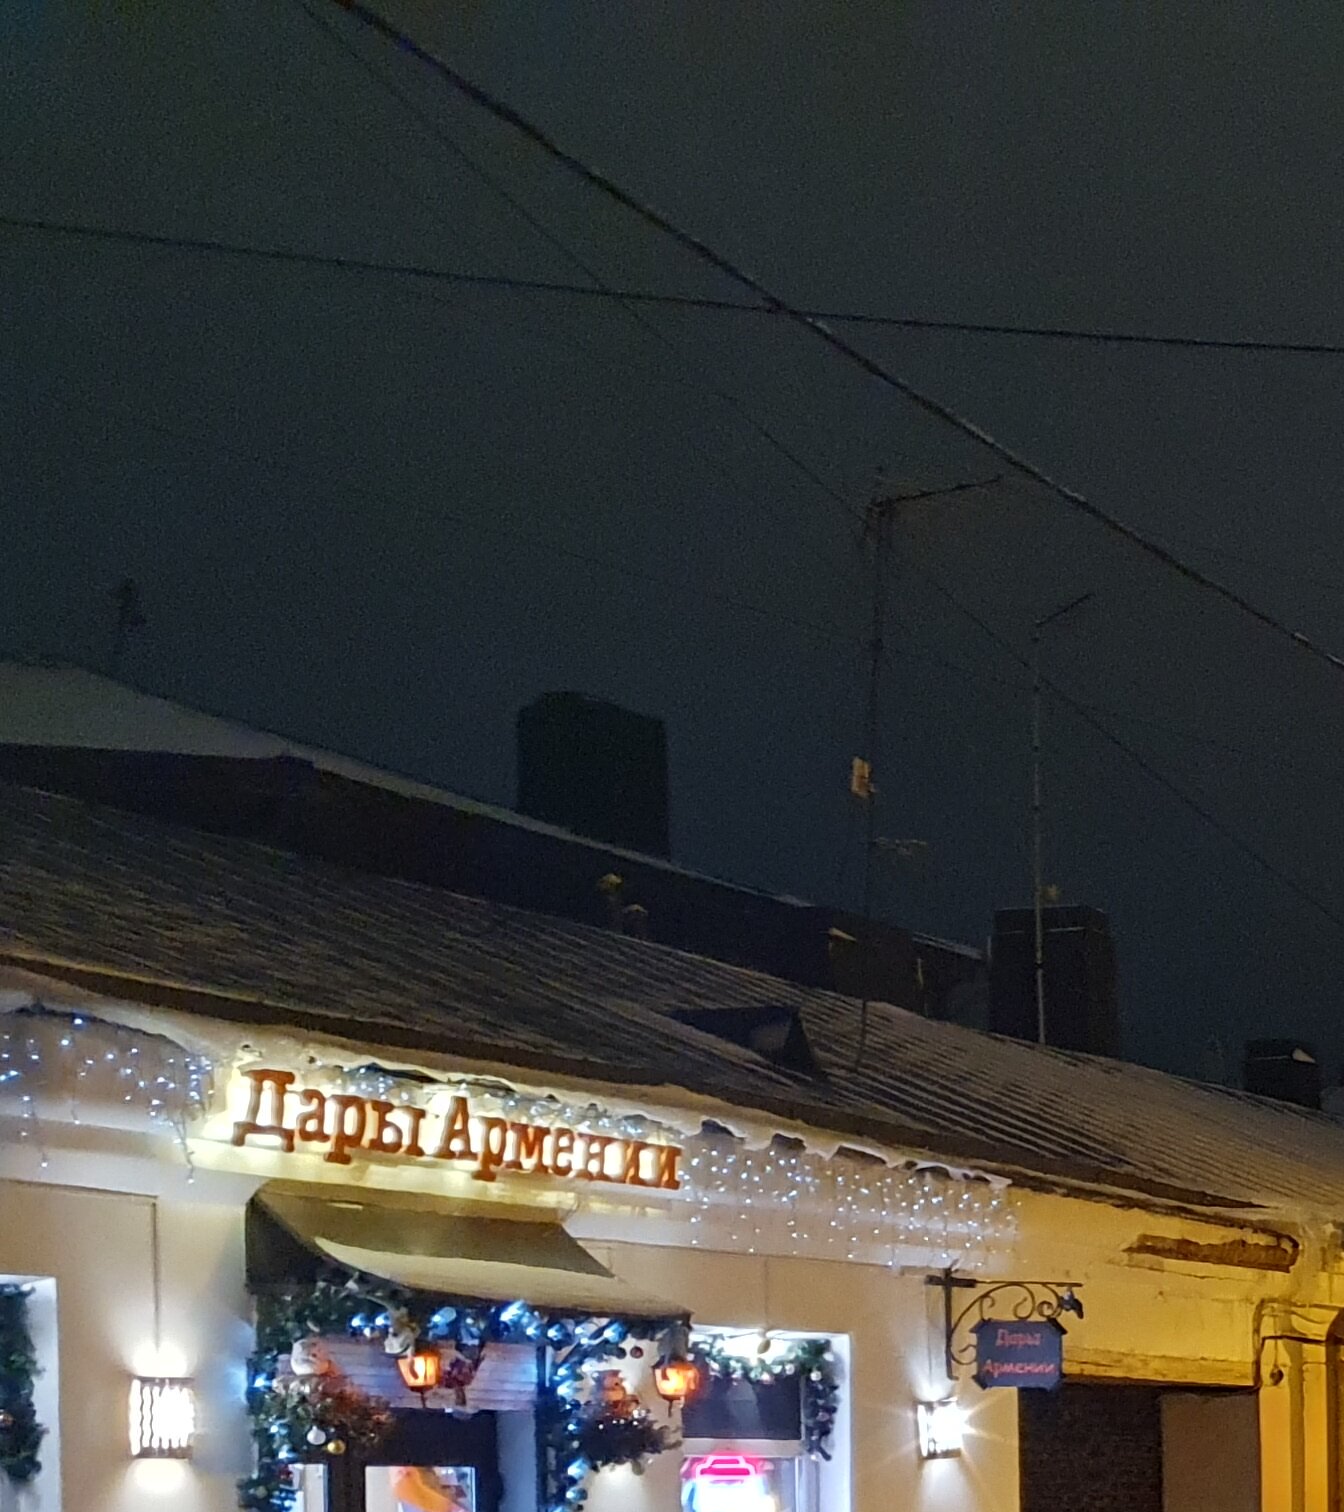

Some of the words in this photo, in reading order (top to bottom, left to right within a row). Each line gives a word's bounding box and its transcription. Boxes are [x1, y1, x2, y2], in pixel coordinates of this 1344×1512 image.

[232, 1068, 426, 1164] Дары
[437, 1096, 683, 1190] Армении
[984, 1360, 1055, 1378] Армении
